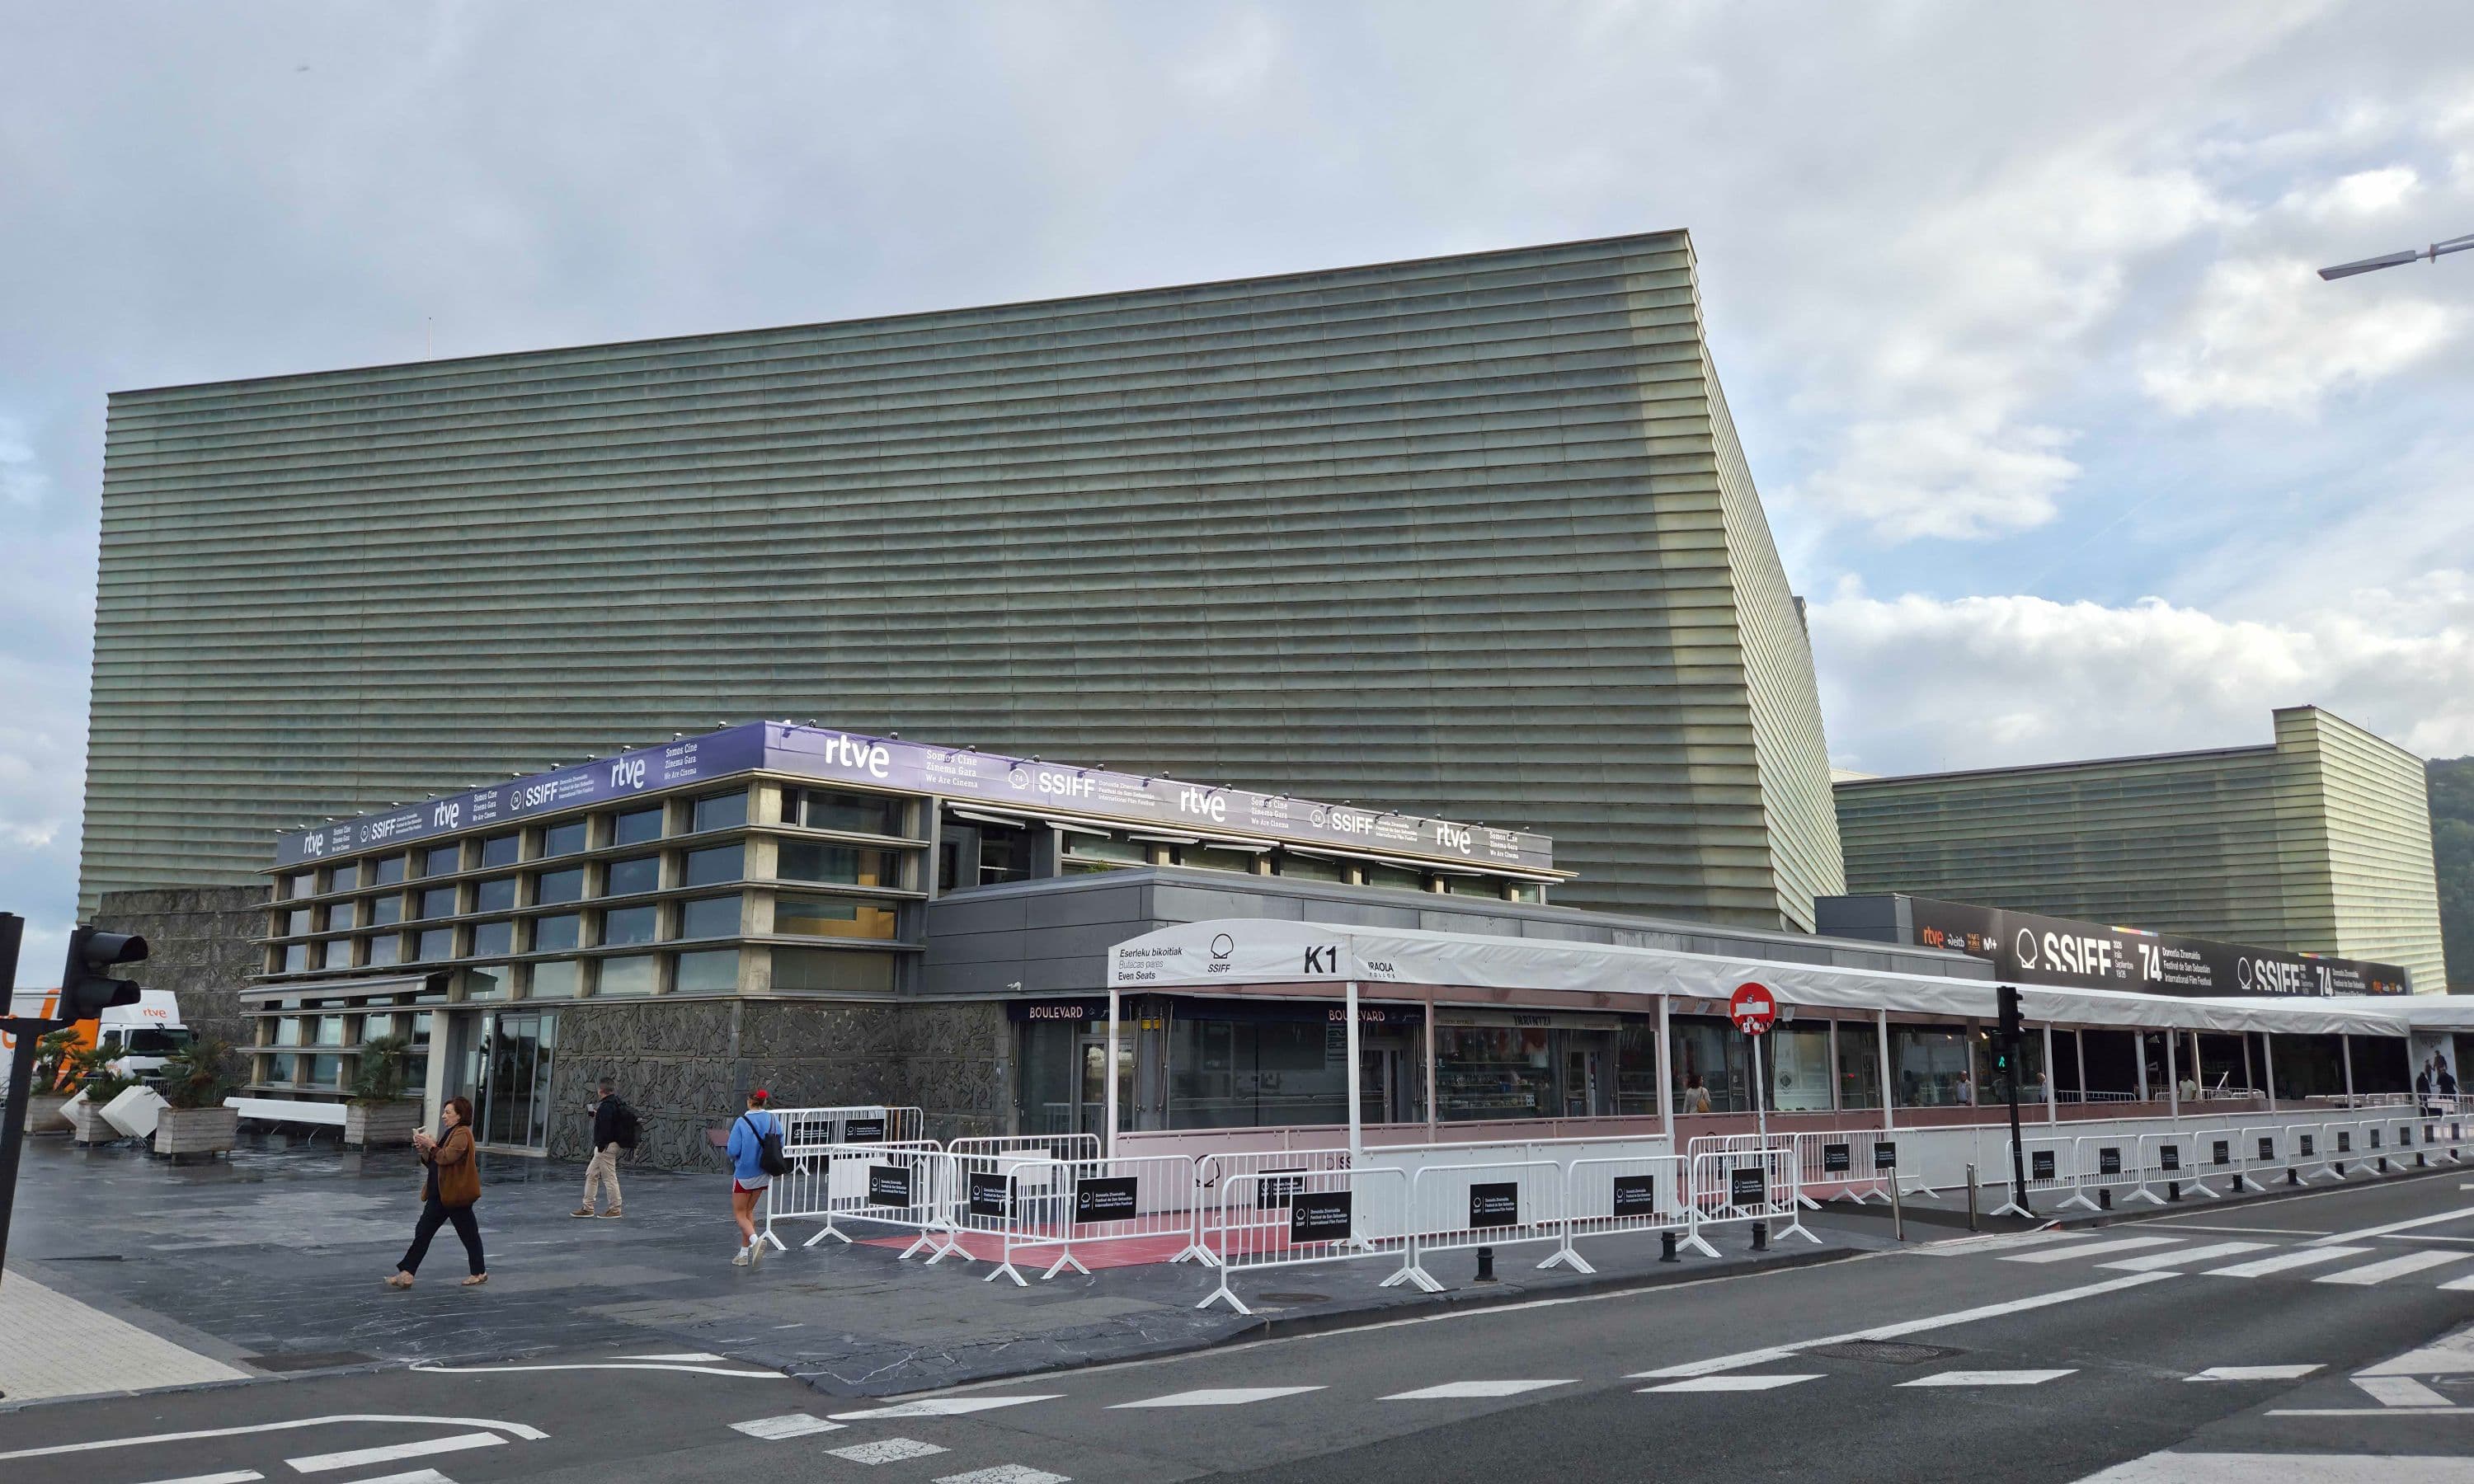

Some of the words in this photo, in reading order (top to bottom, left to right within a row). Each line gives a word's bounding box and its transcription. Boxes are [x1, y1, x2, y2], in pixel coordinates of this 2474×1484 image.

[666, 747, 684, 758] Somos
[684, 743, 698, 754] Cine
[825, 734, 890, 778] rtve
[926, 749, 956, 763] Somos
[957, 754, 977, 765] Cine
[665, 758, 684, 769] Zinema
[684, 755, 697, 764] Gara
[926, 762, 956, 774] Zinema
[958, 767, 976, 777] Gara
[611, 757, 646, 789] rtve
[680, 767, 697, 777] Cinema
[925, 773, 937, 782] We
[938, 776, 951, 784] Are
[952, 777, 978, 788] Cinema
[1038, 772, 1095, 797] SSIFF
[525, 781, 558, 807] SSIFF
[1180, 787, 1226, 823] rtve
[1251, 796, 1272, 808] Somos
[1273, 800, 1288, 810] Cine
[434, 801, 459, 829] rtve
[1251, 807, 1273, 817] Zinema
[1274, 810, 1287, 819] Gara
[371, 817, 396, 840] SSIFF
[1251, 817, 1259, 825] We
[1270, 819, 1289, 829] Cinema
[1332, 811, 1373, 835] SSIFF
[303, 831, 323, 856] rtve
[1437, 823, 1471, 854] rtve
[1489, 830, 1506, 841] Somos
[1506, 833, 1518, 843] Cine
[1489, 840, 1507, 849] Zinema
[1507, 843, 1518, 851] Gara
[1504, 851, 1519, 859] Cinema
[1923, 925, 1945, 950] rtve
[1953, 936, 1964, 947] eitb
[1119, 948, 1150, 958] Eserleku
[1151, 946, 1183, 956] bikoitiak
[2044, 932, 2111, 976] SSIFF
[2162, 946, 2180, 958] Donostia
[2180, 949, 2201, 960] Zinemaldia
[1119, 960, 1145, 970] Butacas
[1304, 946, 1337, 974] K1
[2138, 943, 2162, 982] 74
[2163, 960, 2179, 970] Festival
[2179, 962, 2185, 971] de
[2185, 963, 2193, 972] San
[1118, 971, 1134, 980] Even
[1136, 970, 1156, 980] Seats
[1207, 964, 1230, 973] SSIFF
[2255, 958, 2300, 993] SSIFF
[2165, 973, 2189, 984] International
[2189, 974, 2198, 984] Film
[2198, 976, 2212, 986] Festival
[2316, 965, 2334, 997] 74
[143, 1008, 167, 1018] rtve
[1029, 1006, 1084, 1019] BOULEVARD
[1329, 1009, 1385, 1021] BOUEVARD
